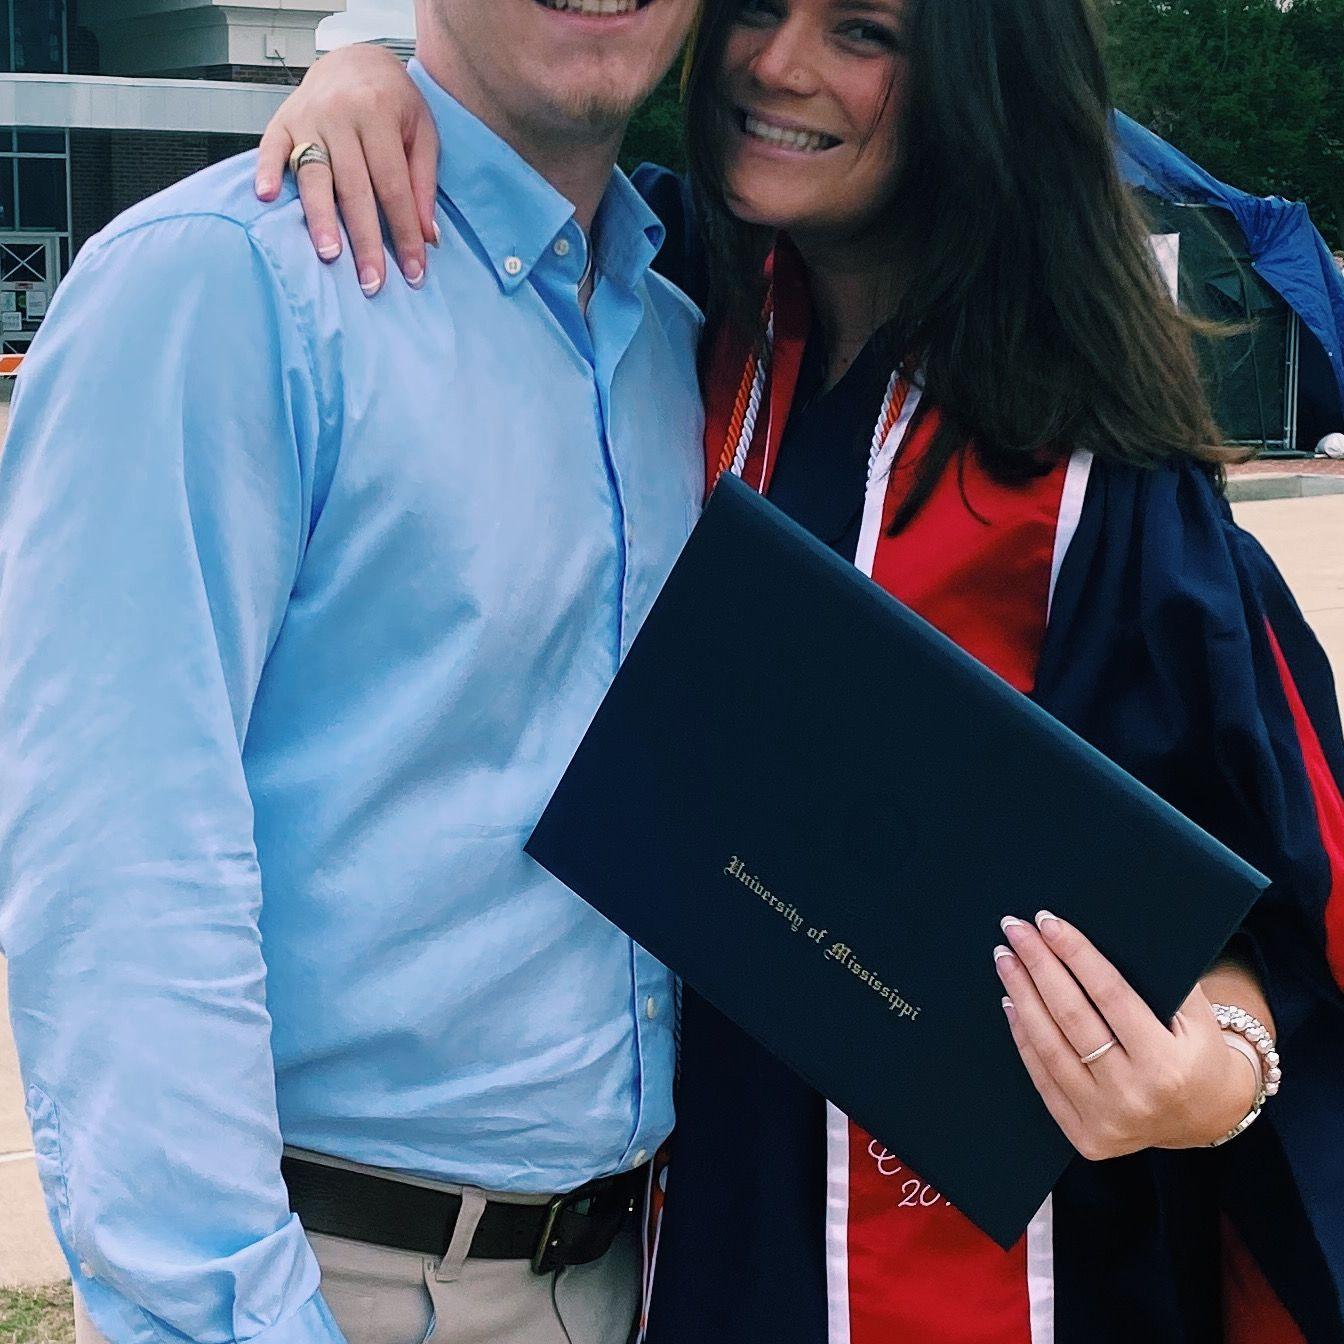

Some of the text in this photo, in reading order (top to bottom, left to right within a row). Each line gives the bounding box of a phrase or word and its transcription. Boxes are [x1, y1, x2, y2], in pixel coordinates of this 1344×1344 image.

[724, 855, 922, 1021] University of Mississippi
[898, 1179, 951, 1207] 20
